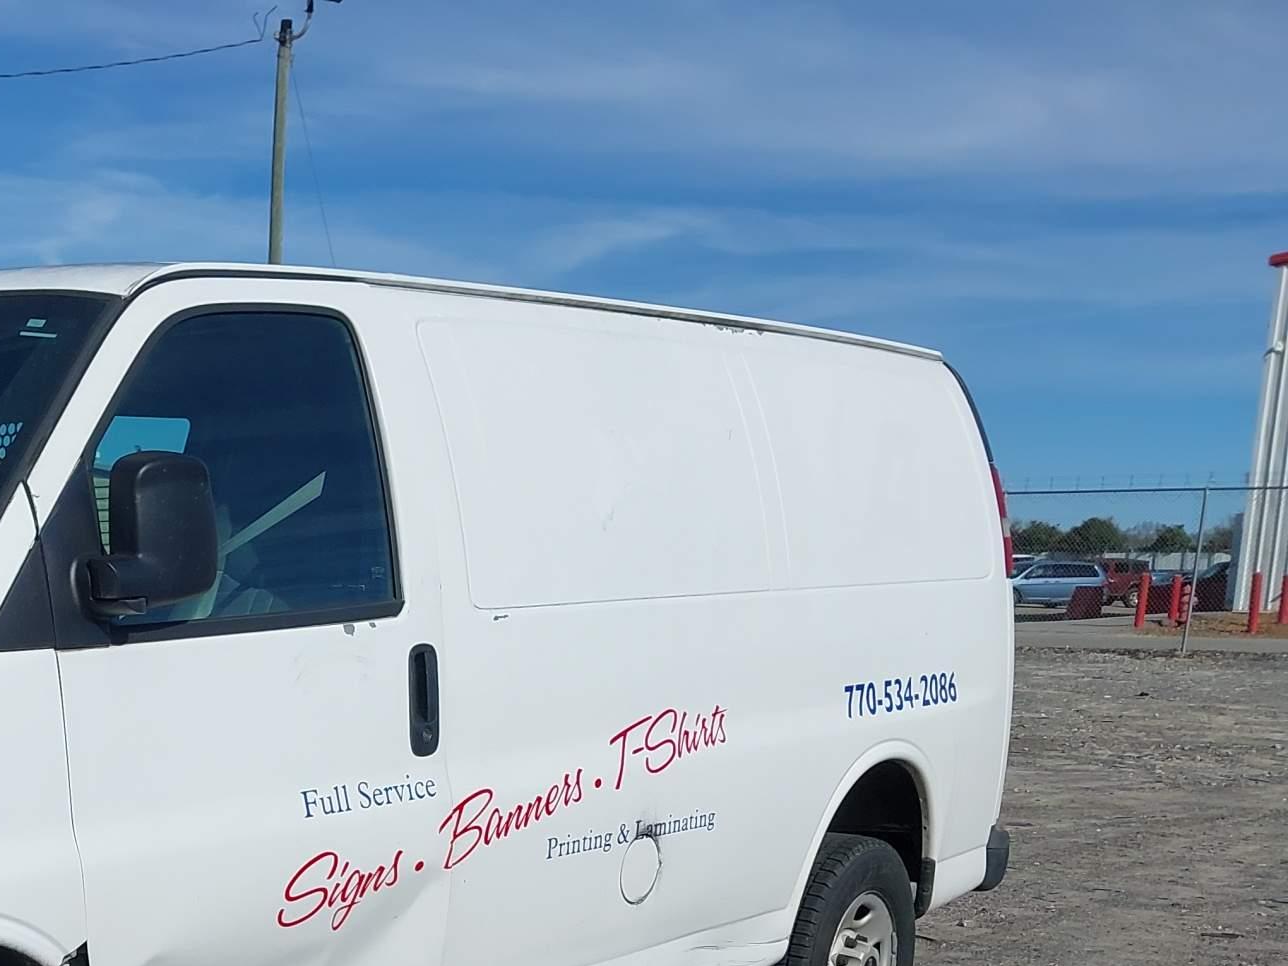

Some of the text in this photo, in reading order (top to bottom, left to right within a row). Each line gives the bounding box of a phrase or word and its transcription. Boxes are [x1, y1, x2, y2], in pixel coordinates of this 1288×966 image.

[844, 671, 958, 720] 770-534-2086
[277, 704, 728, 931] Signs Banners T-Shirts
[301, 774, 437, 818] Full Service
[545, 808, 716, 860] Printing & Laminating
